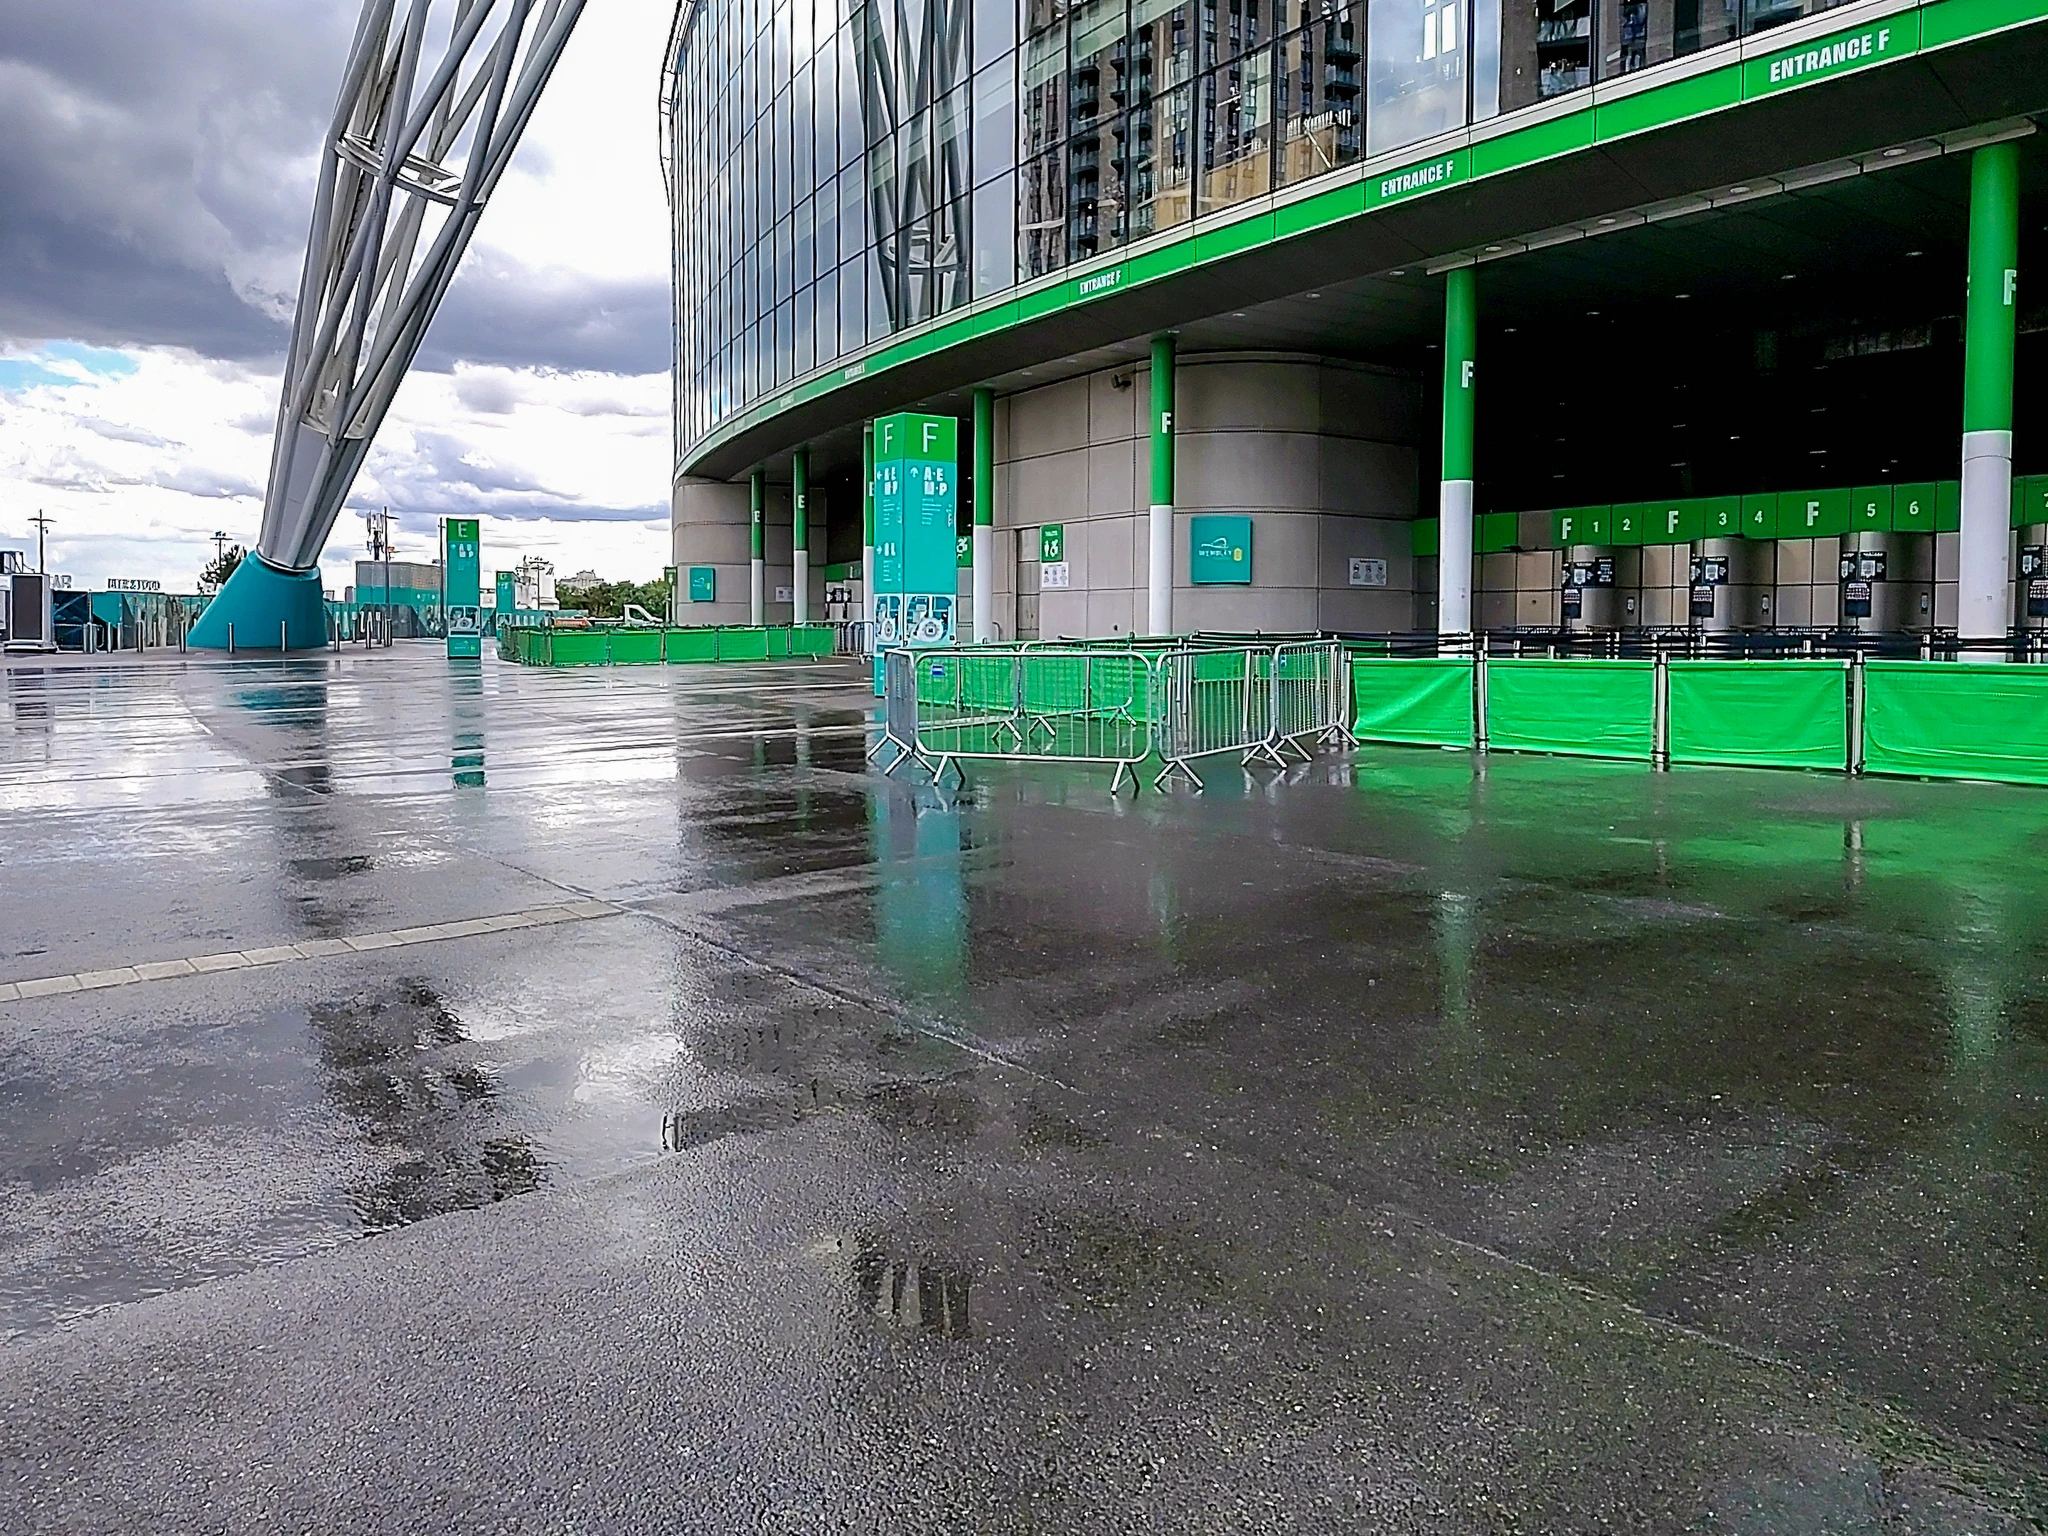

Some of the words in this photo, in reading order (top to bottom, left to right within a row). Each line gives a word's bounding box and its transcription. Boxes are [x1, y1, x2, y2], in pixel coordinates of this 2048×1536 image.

[1770, 33, 1872, 83] ENTRANCE
[1878, 28, 1890, 51] F
[1381, 163, 1444, 198] ENTRANCE
[1446, 160, 1454, 178] F
[2003, 269, 2017, 305] F
[1461, 360, 1474, 388] F
[922, 422, 939, 453] F
[1161, 411, 1171, 434] F
[884, 423, 894, 454] F
[754, 510, 761, 523] E
[797, 494, 805, 509] E
[457, 521, 468, 538] E
[1561, 518, 1572, 540] F
[1593, 521, 1599, 533] 1
[1622, 518, 1631, 531] 2
[1668, 510, 1679, 534] F
[1718, 512, 1728, 526] 3
[1754, 510, 1763, 524] 4
[1806, 501, 1820, 527] F
[1866, 503, 1876, 517] 5
[1909, 501, 1919, 515] 6
